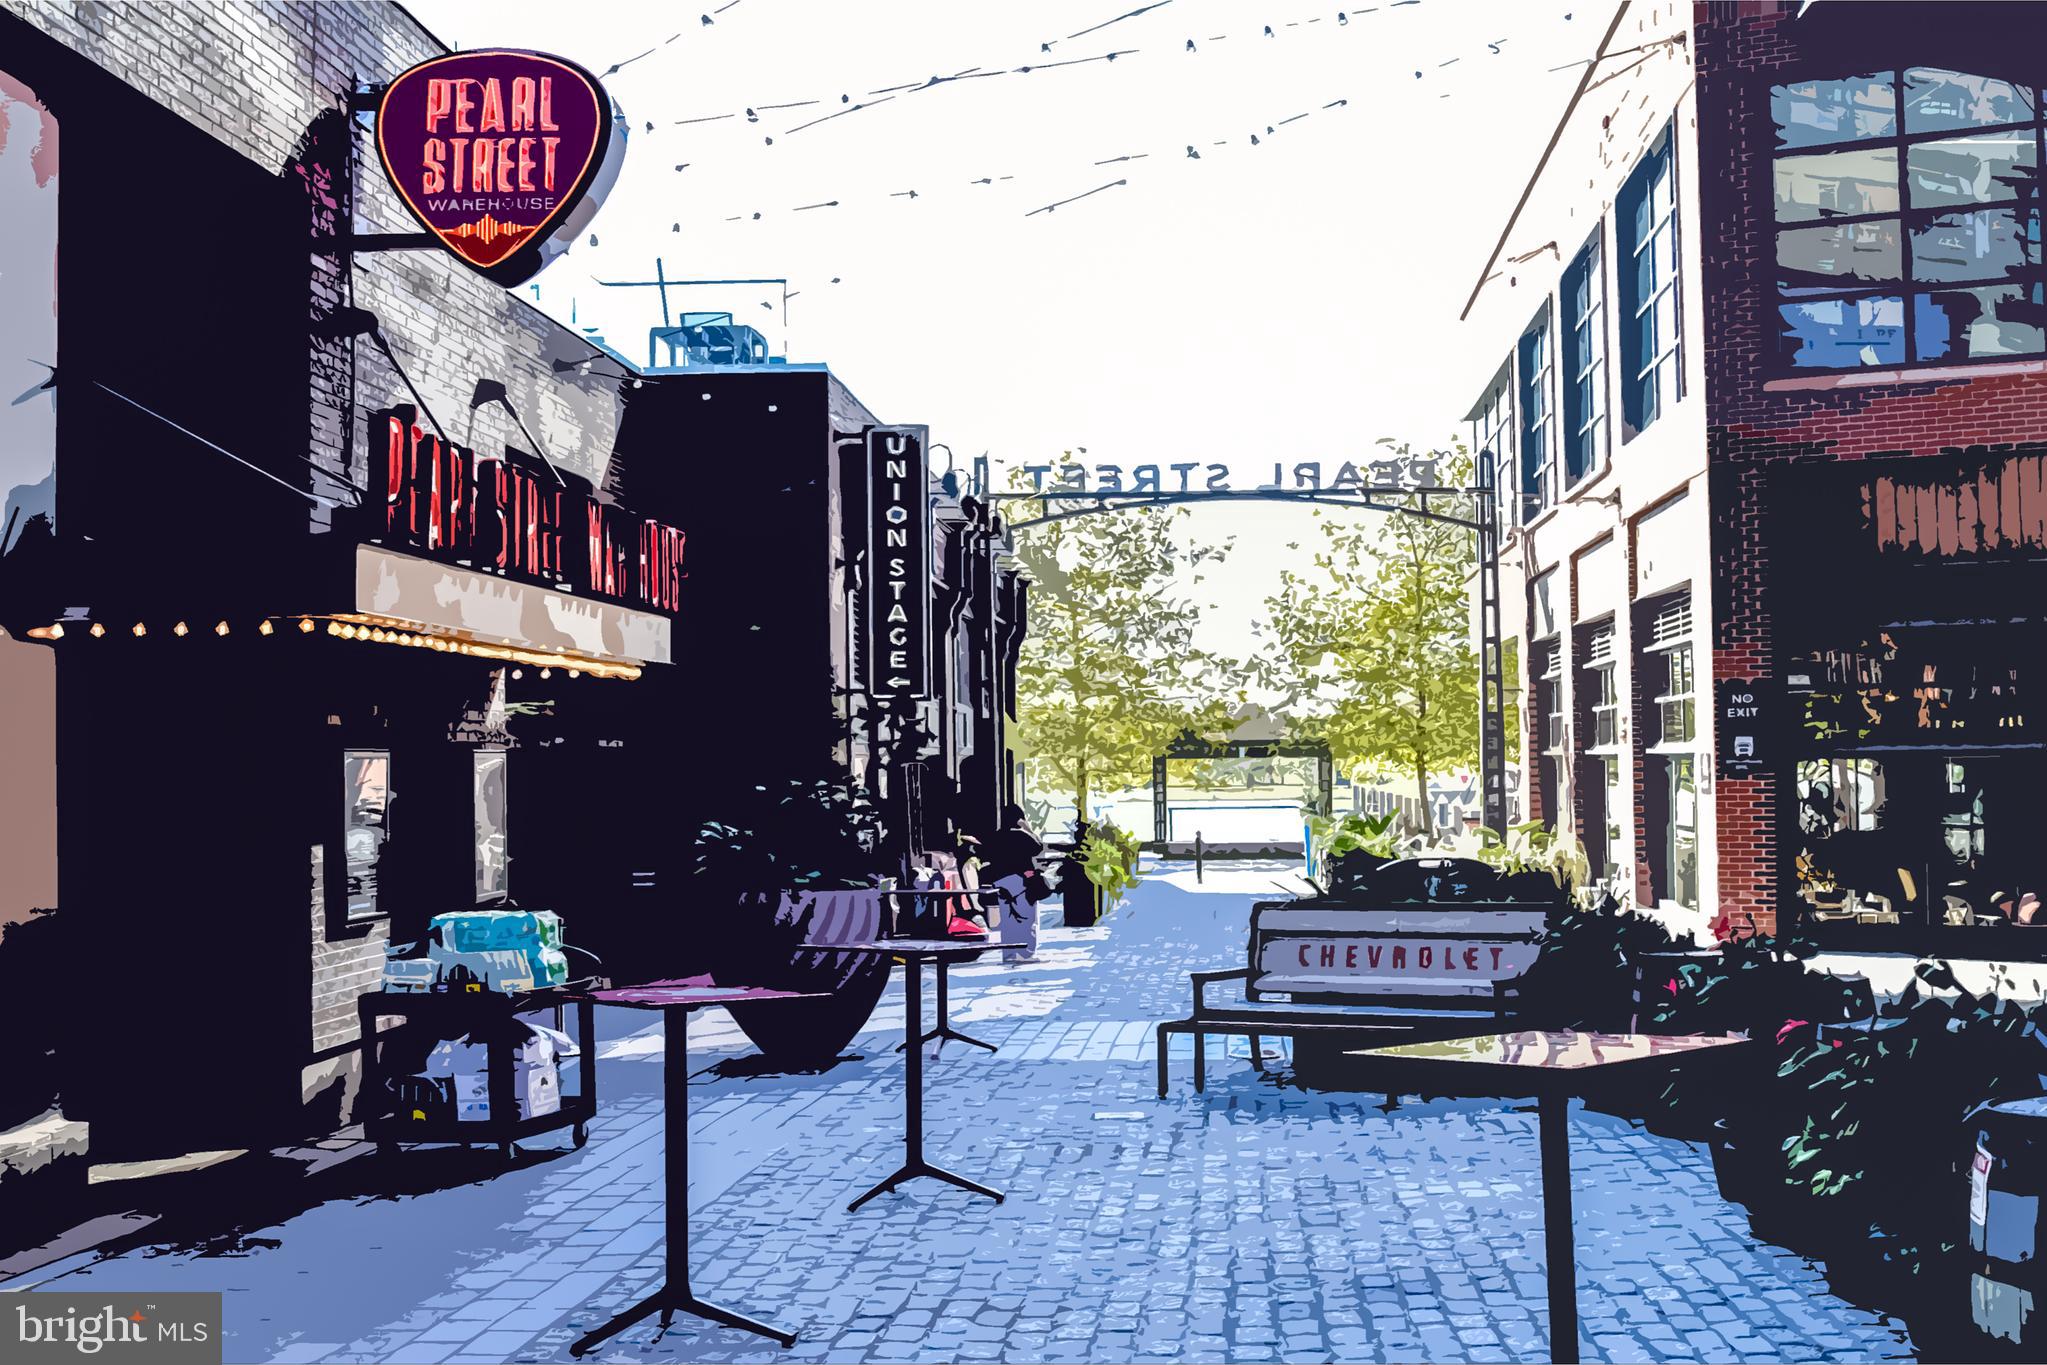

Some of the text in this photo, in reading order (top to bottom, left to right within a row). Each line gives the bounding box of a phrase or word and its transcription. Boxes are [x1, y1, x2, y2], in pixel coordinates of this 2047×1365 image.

[426, 76, 559, 133] PEARL
[423, 137, 561, 194] STREET
[427, 197, 555, 212] WAREHOUSE
[886, 437, 908, 668] UNION STAGE
[1727, 707, 1759, 718] EXIT
[1731, 694, 1754, 704] NO
[1298, 944, 1504, 971] CHEVROLET
